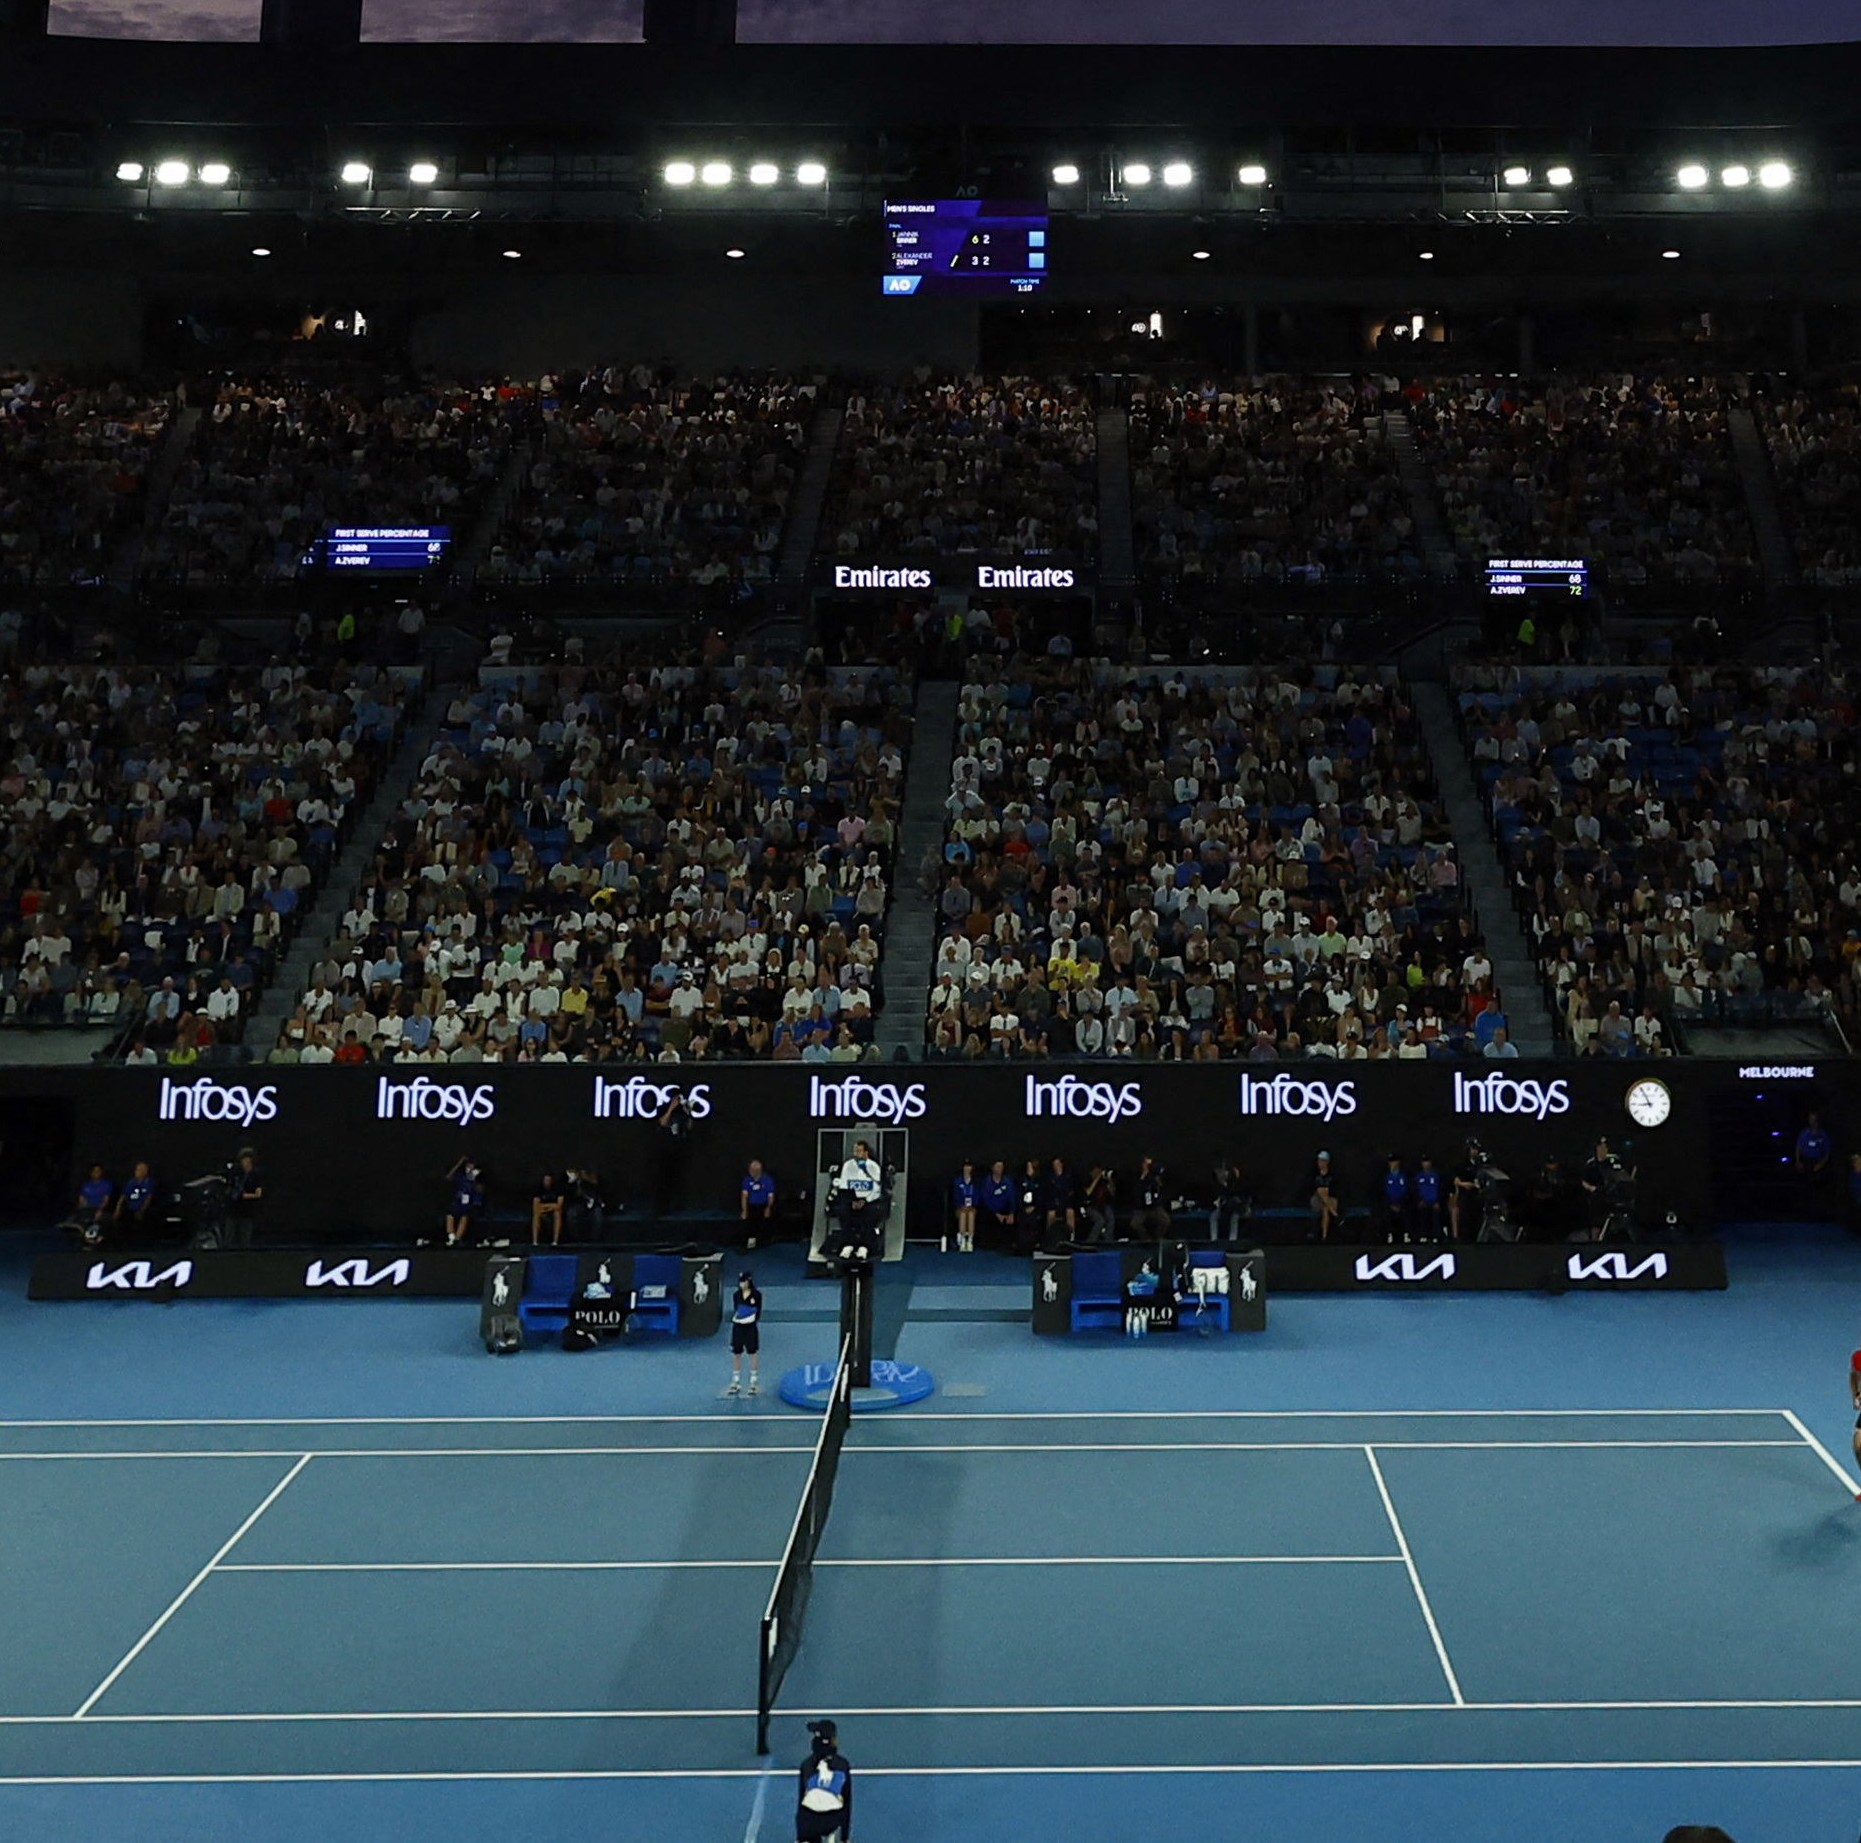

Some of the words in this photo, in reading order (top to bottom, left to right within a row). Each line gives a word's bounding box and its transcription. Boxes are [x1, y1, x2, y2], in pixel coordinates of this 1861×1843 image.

[972, 235, 979, 244] 6
[983, 235, 990, 244] 2
[972, 256, 979, 265] 3
[983, 256, 990, 265] 2
[889, 279, 911, 291] AO
[335, 529, 355, 537] FIRST
[356, 529, 379, 538] SERVE
[380, 529, 429, 538] PERCENTAGE
[1489, 560, 1508, 568] FIRST
[1510, 560, 1533, 568] SERVE
[1534, 560, 1583, 569] PERCENTAGE
[835, 565, 931, 587] Emirates
[978, 565, 1074, 587] Emirates
[1568, 574, 1581, 583] 68
[1570, 586, 1582, 595] 72
[1739, 1067, 1814, 1078] MELBOURNE
[160, 1078, 277, 1126] Infosys
[378, 1076, 494, 1126] Infosys
[811, 1076, 926, 1124] Infosys
[1027, 1075, 1141, 1123] Infosys
[1242, 1073, 1356, 1121] Infosys
[1455, 1072, 1569, 1120] Infosys
[575, 1310, 621, 1324] POLO
